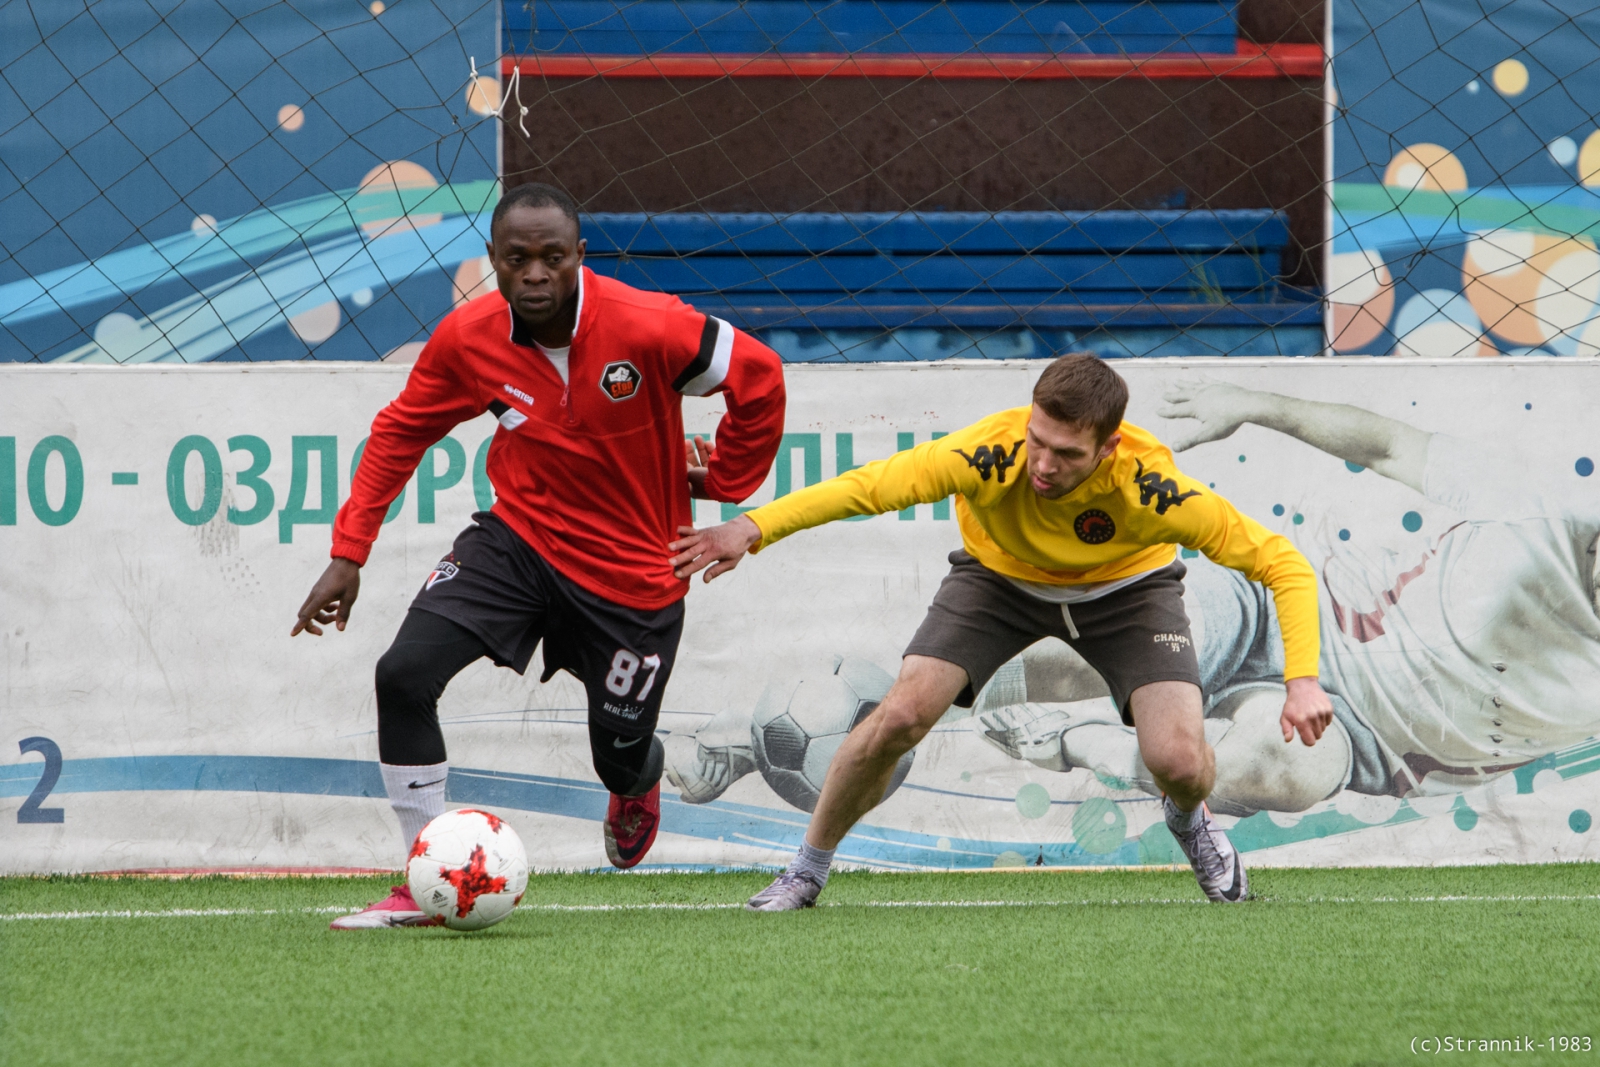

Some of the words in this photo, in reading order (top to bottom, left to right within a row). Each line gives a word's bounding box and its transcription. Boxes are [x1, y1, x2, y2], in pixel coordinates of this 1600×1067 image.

[605, 648, 661, 701] 87
[603, 702, 621, 715] REAL
[621, 711, 639, 720] SPORT
[16, 736, 65, 824] 2
